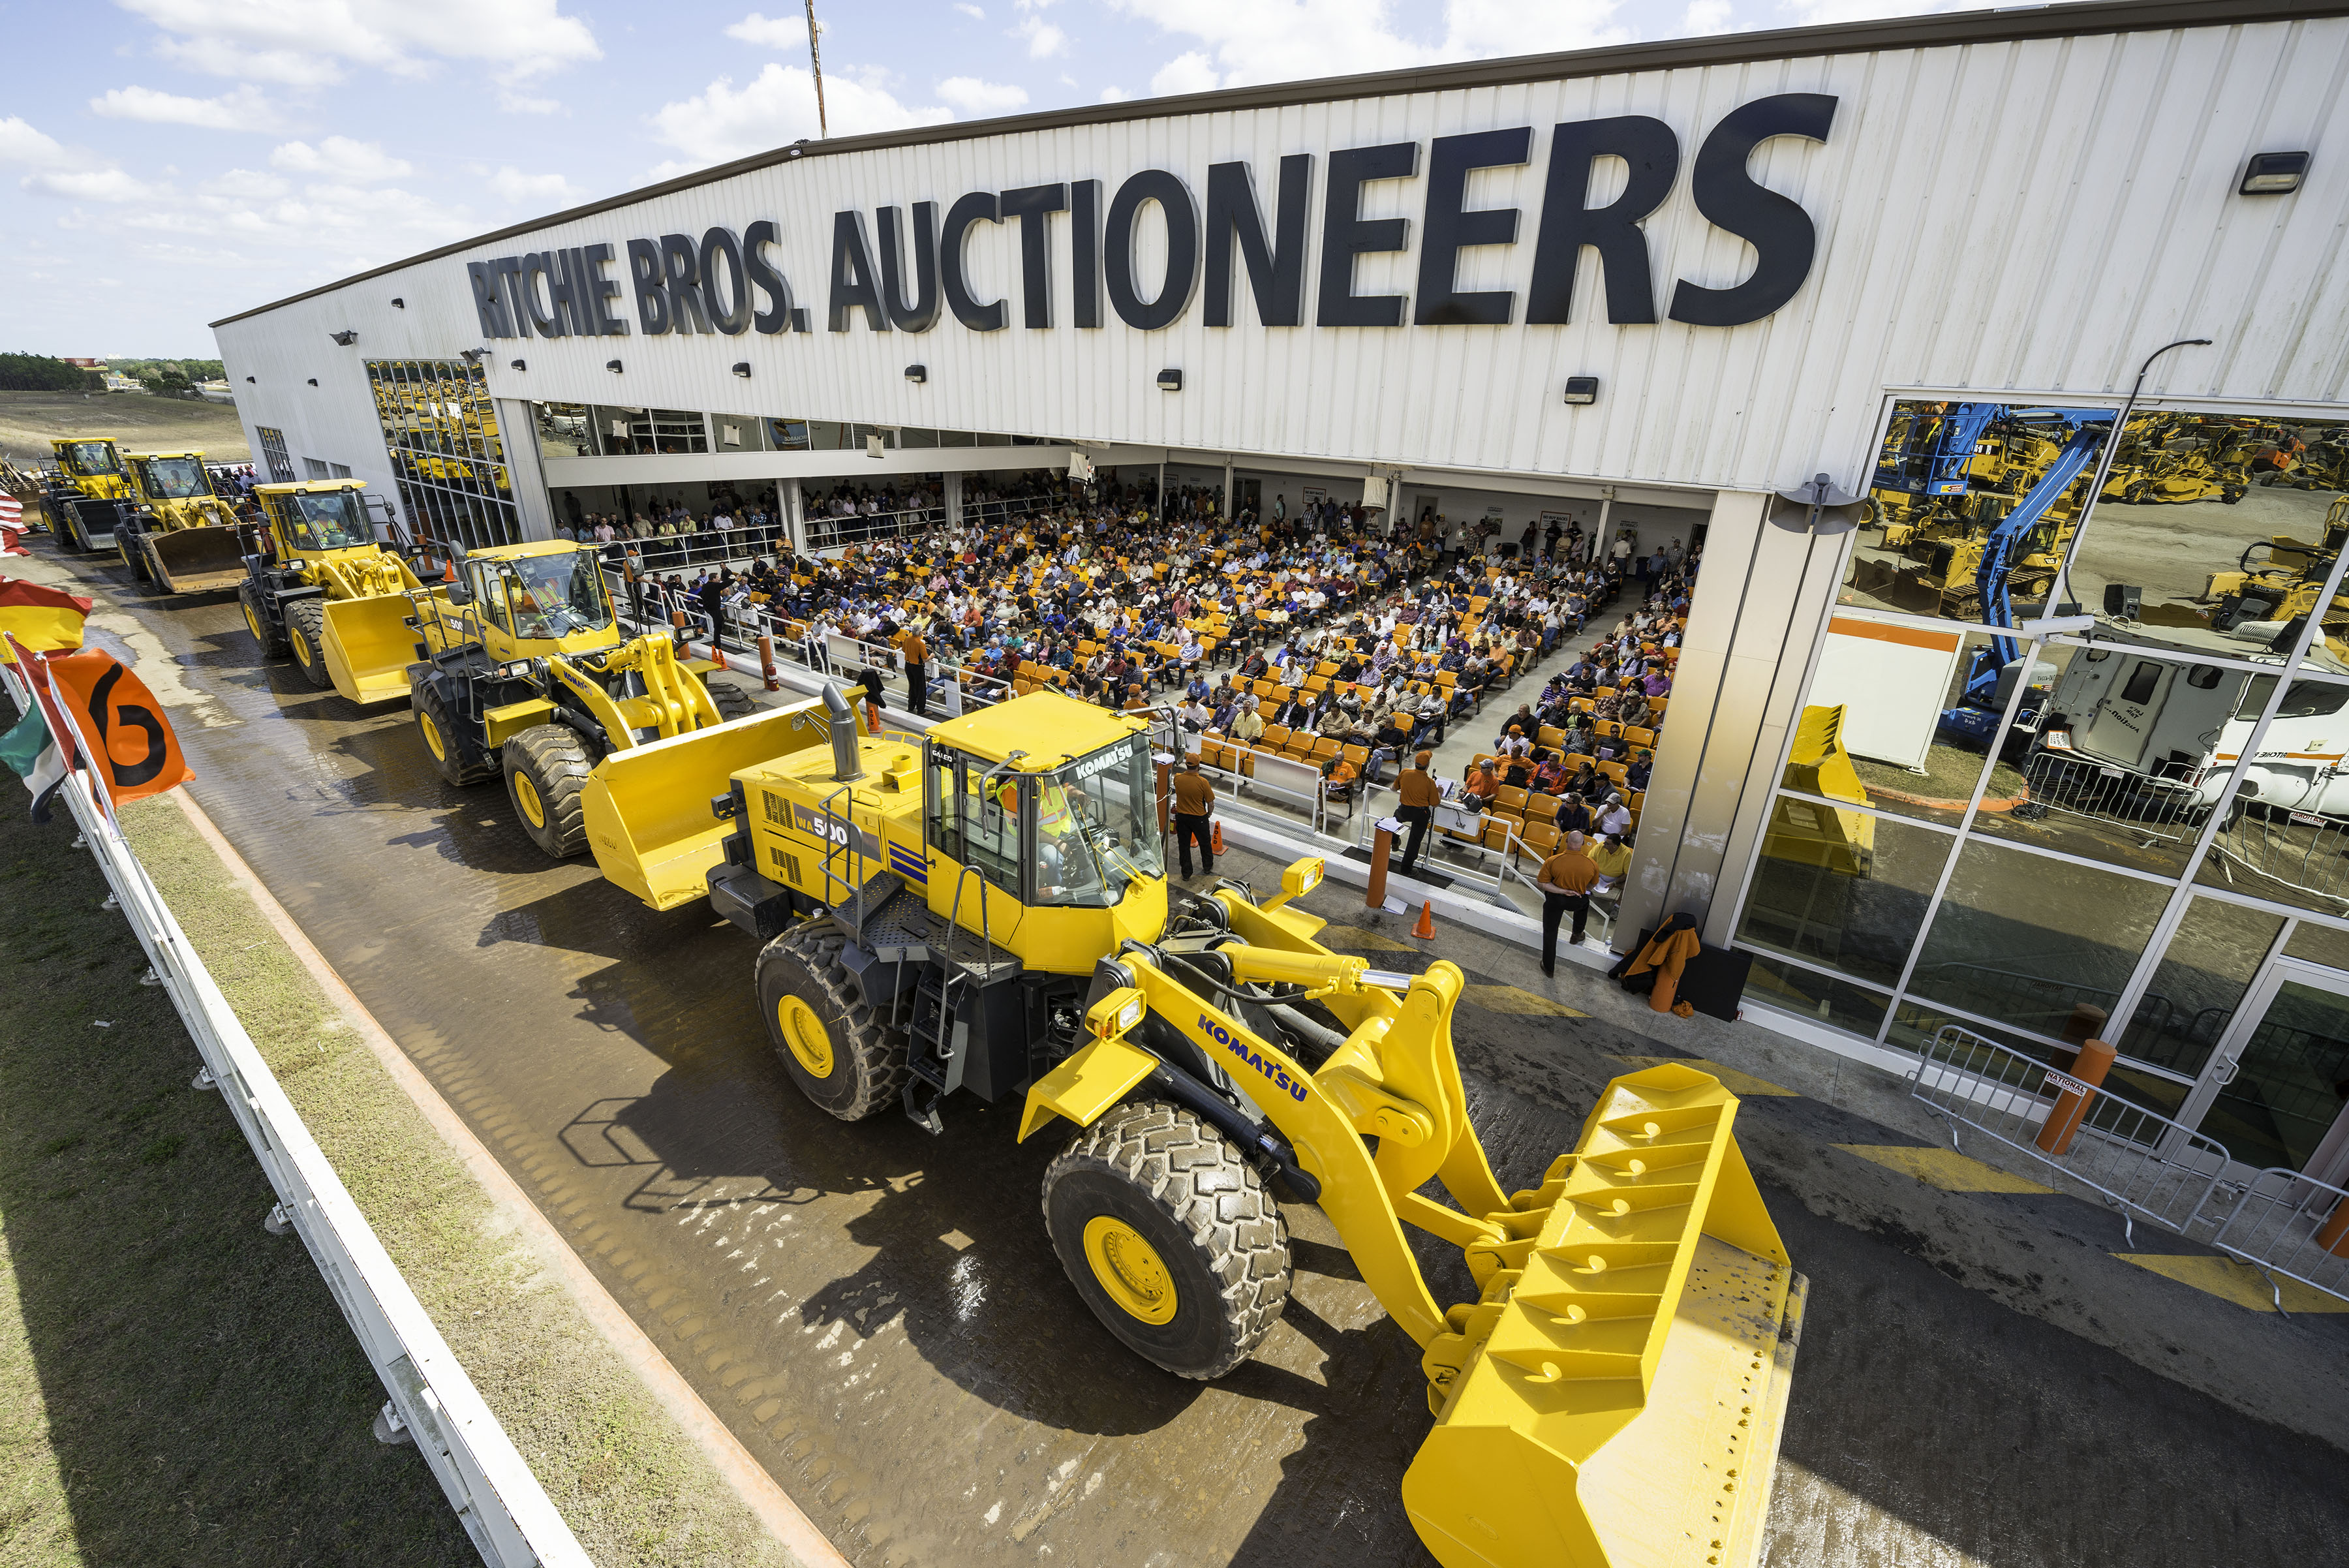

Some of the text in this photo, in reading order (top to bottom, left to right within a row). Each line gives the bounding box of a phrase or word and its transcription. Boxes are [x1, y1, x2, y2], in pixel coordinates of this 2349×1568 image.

[467, 93, 1839, 339] RITCHIE BROS. AUCTIONEERS
[563, 670, 593, 697] KOMATSU
[932, 749, 953, 762] GALEO
[1076, 743, 1133, 780] KOMATSU
[1197, 1013, 1308, 1102] KOMATSU
[2048, 1072, 2085, 1092] NATIONAL
